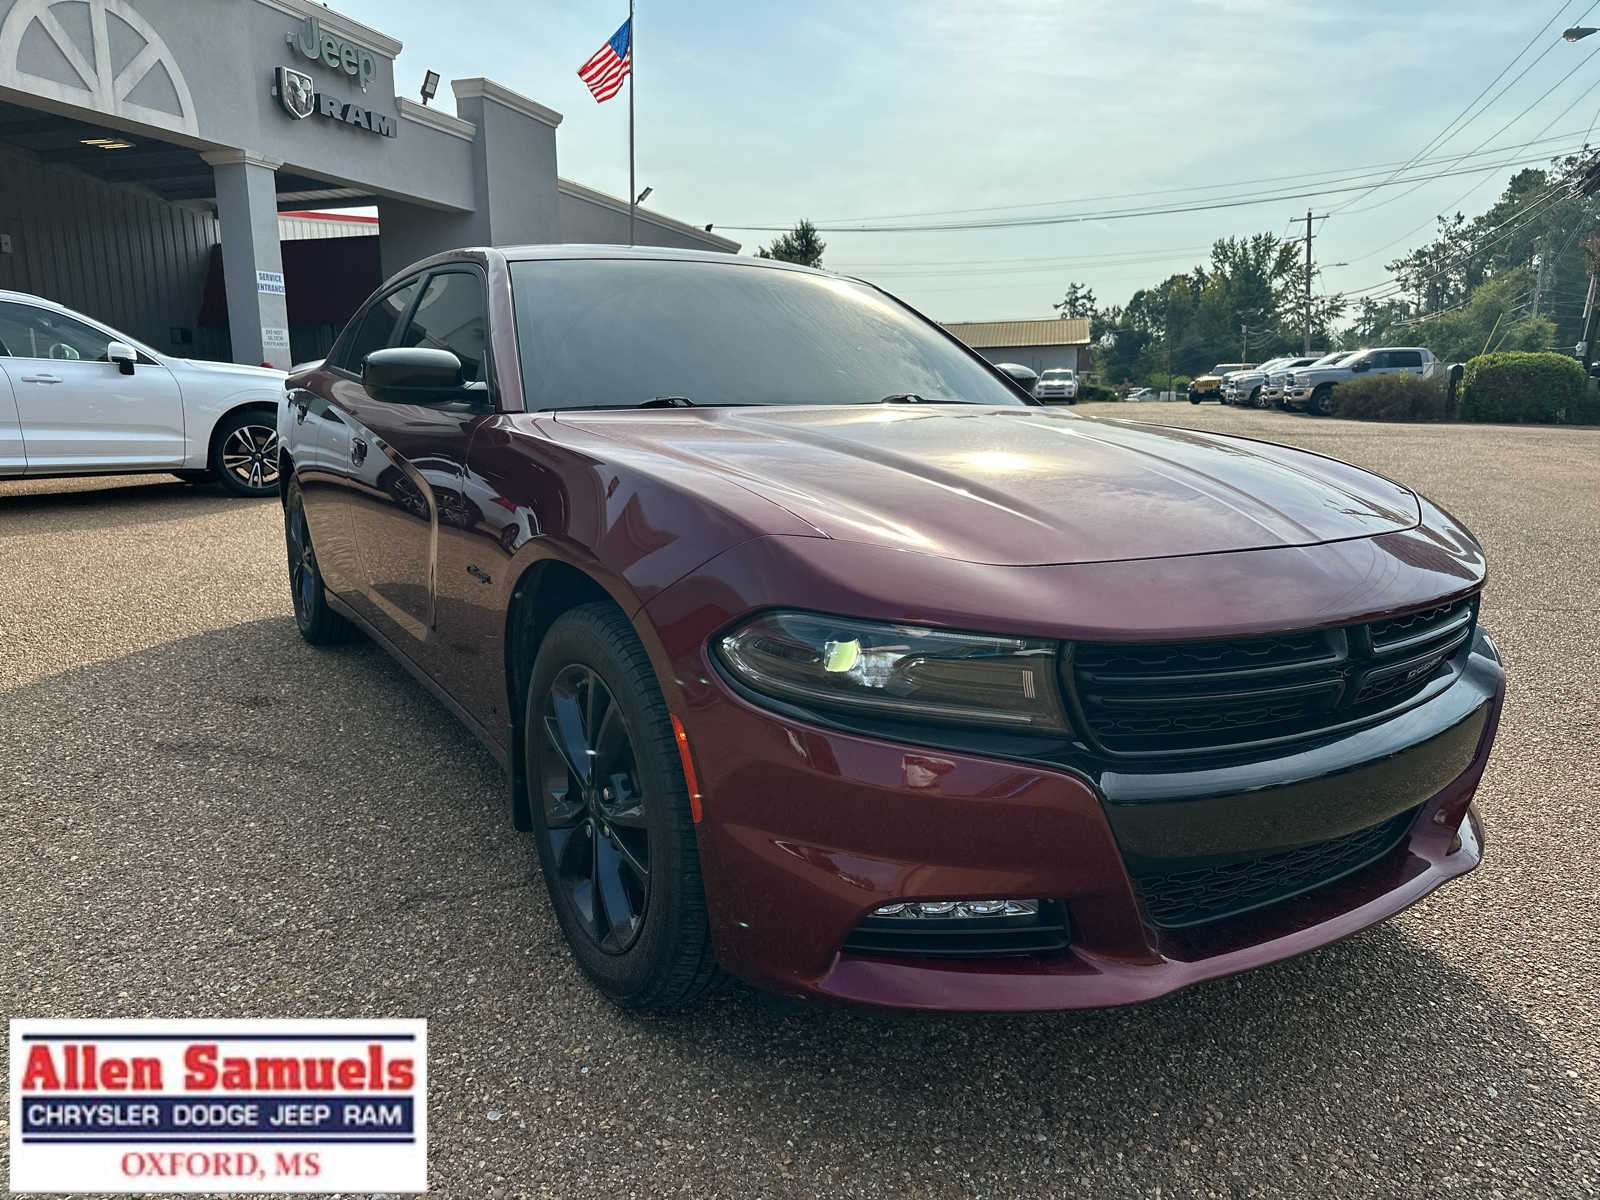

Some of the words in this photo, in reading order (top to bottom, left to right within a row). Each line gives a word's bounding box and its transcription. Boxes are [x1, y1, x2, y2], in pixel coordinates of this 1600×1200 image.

[286, 16, 376, 94] Jeep
[314, 93, 397, 138] RAM
[258, 272, 282, 282] SERVICE
